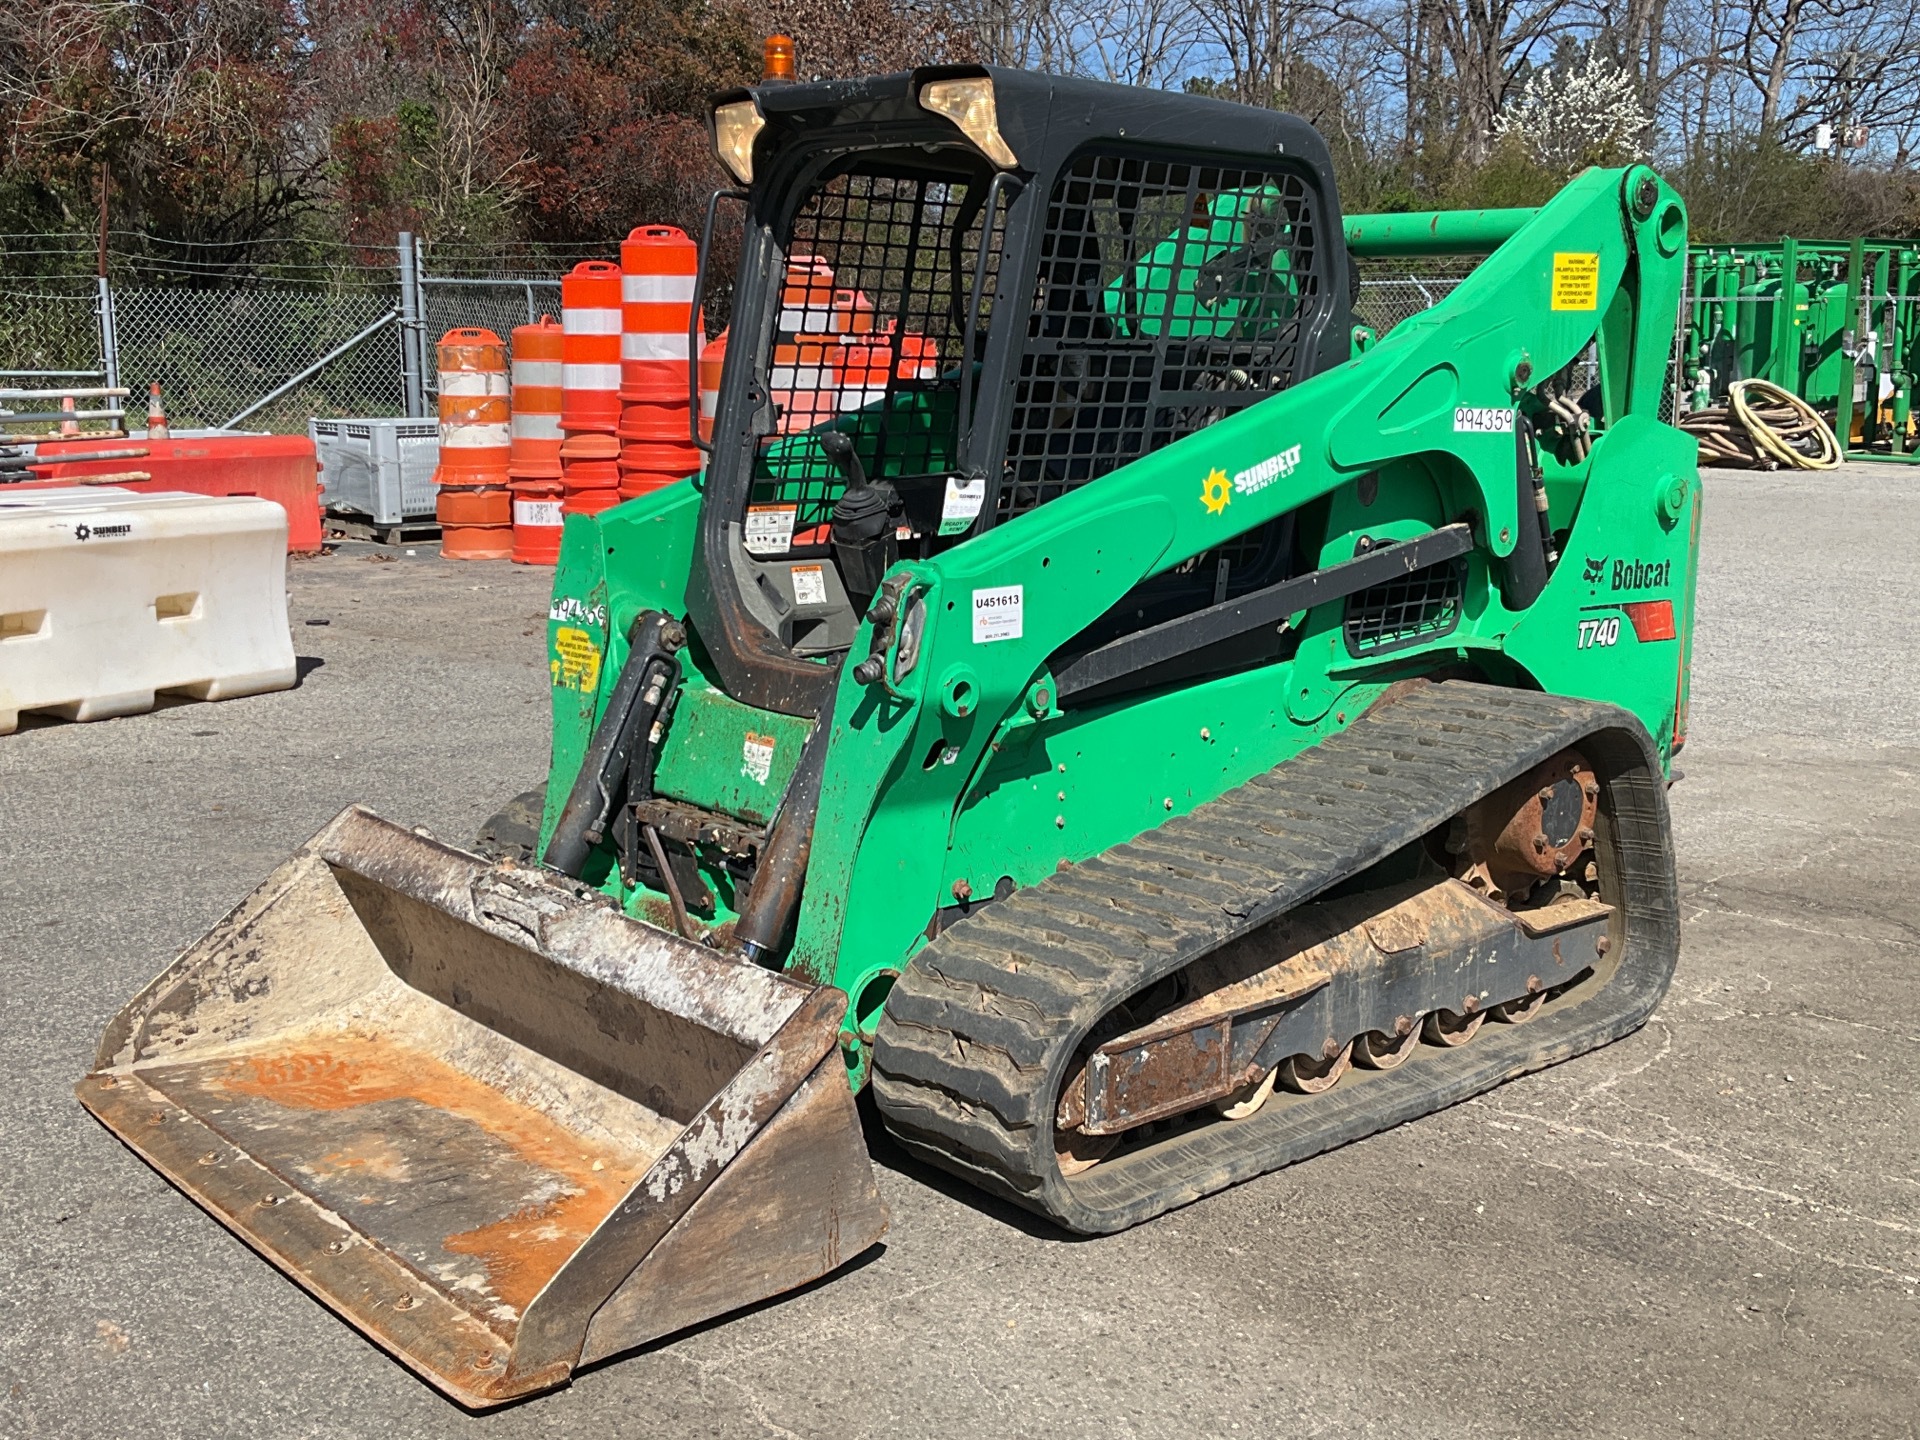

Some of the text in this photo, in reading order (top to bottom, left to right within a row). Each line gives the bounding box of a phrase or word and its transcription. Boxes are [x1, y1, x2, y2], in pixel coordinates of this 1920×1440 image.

[1456, 408, 1513, 431] 994359
[1233, 443, 1302, 493] SUNBELT
[92, 524, 131, 535] SUNBELT
[1611, 558, 1671, 591] Bobcat
[976, 594, 1019, 609] U451613
[1577, 616, 1620, 650] T740
